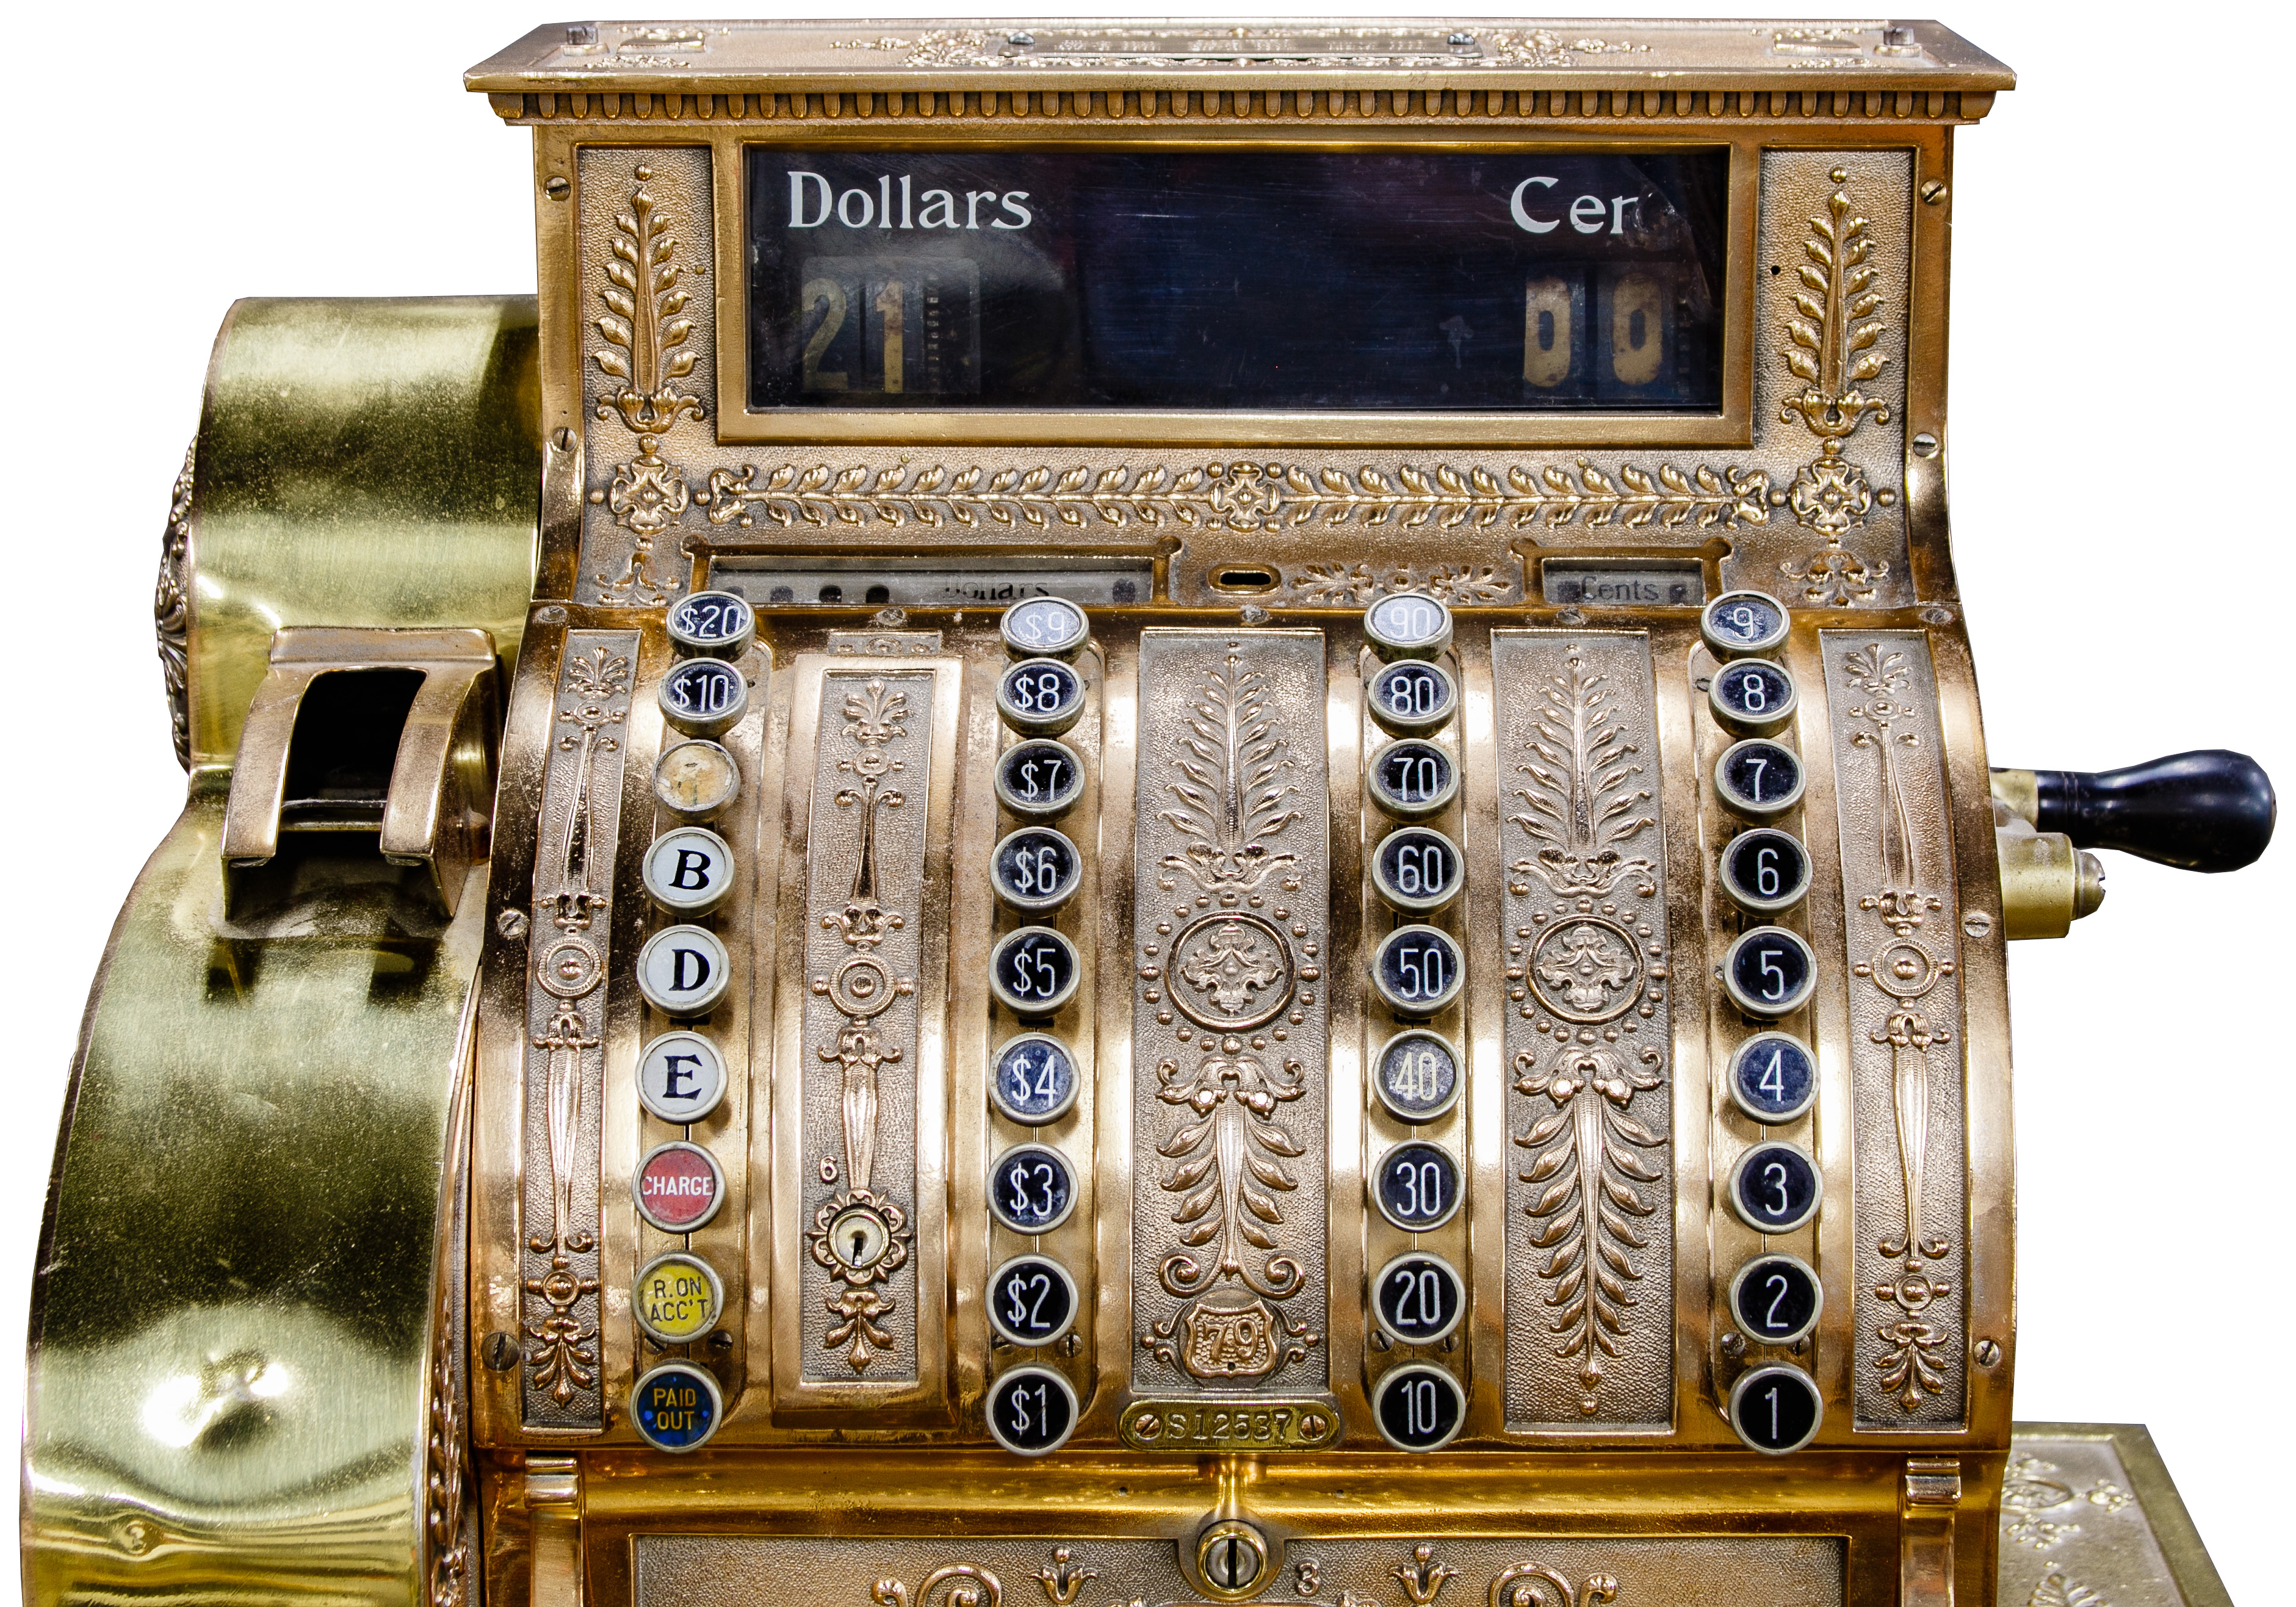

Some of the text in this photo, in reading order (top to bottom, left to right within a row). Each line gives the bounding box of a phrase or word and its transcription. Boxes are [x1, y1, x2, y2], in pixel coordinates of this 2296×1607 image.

[787, 171, 1032, 229] Dollars
[1582, 575, 1659, 601] Cents
[679, 604, 741, 638] $20
[1025, 611, 1066, 642] $9
[1390, 605, 1431, 639] 90
[1732, 607, 1755, 640] 9
[673, 674, 730, 713] $10
[1014, 673, 1060, 712] $8
[1390, 676, 1434, 715] 80
[1743, 673, 1766, 712] 8
[1020, 759, 1062, 802] $7
[1392, 757, 1438, 801] 70
[1745, 758, 1767, 803] 7
[668, 849, 710, 890] B
[1014, 846, 1057, 894] $6
[1398, 845, 1444, 894] 60
[1757, 847, 1780, 895] 6
[668, 948, 710, 992] D
[1013, 948, 1056, 997] $5
[1399, 947, 1444, 999] 50
[1760, 950, 1785, 1001] 5
[662, 1053, 703, 1101] E
[1012, 1053, 1058, 1108] $4
[1394, 1051, 1438, 1102] 40
[1758, 1049, 1785, 1102] 4
[642, 1175, 713, 1196] CHARGE
[818, 1154, 839, 1183] 6
[1009, 1162, 1054, 1217] $3
[1396, 1161, 1441, 1217] 30
[1764, 1162, 1788, 1217] 3
[651, 1299, 708, 1322] ACC'T
[1007, 1273, 1051, 1329] $2
[1395, 1269, 1441, 1326] 20
[1766, 1274, 1789, 1329] 2
[1202, 1318, 1258, 1360] 79
[654, 1387, 696, 1407] PAID
[1011, 1384, 1047, 1436] $1
[1401, 1380, 1437, 1435] 10
[1764, 1387, 1778, 1440] 1
[657, 1411, 695, 1431] OUT
[1295, 1558, 1319, 1597] 3
